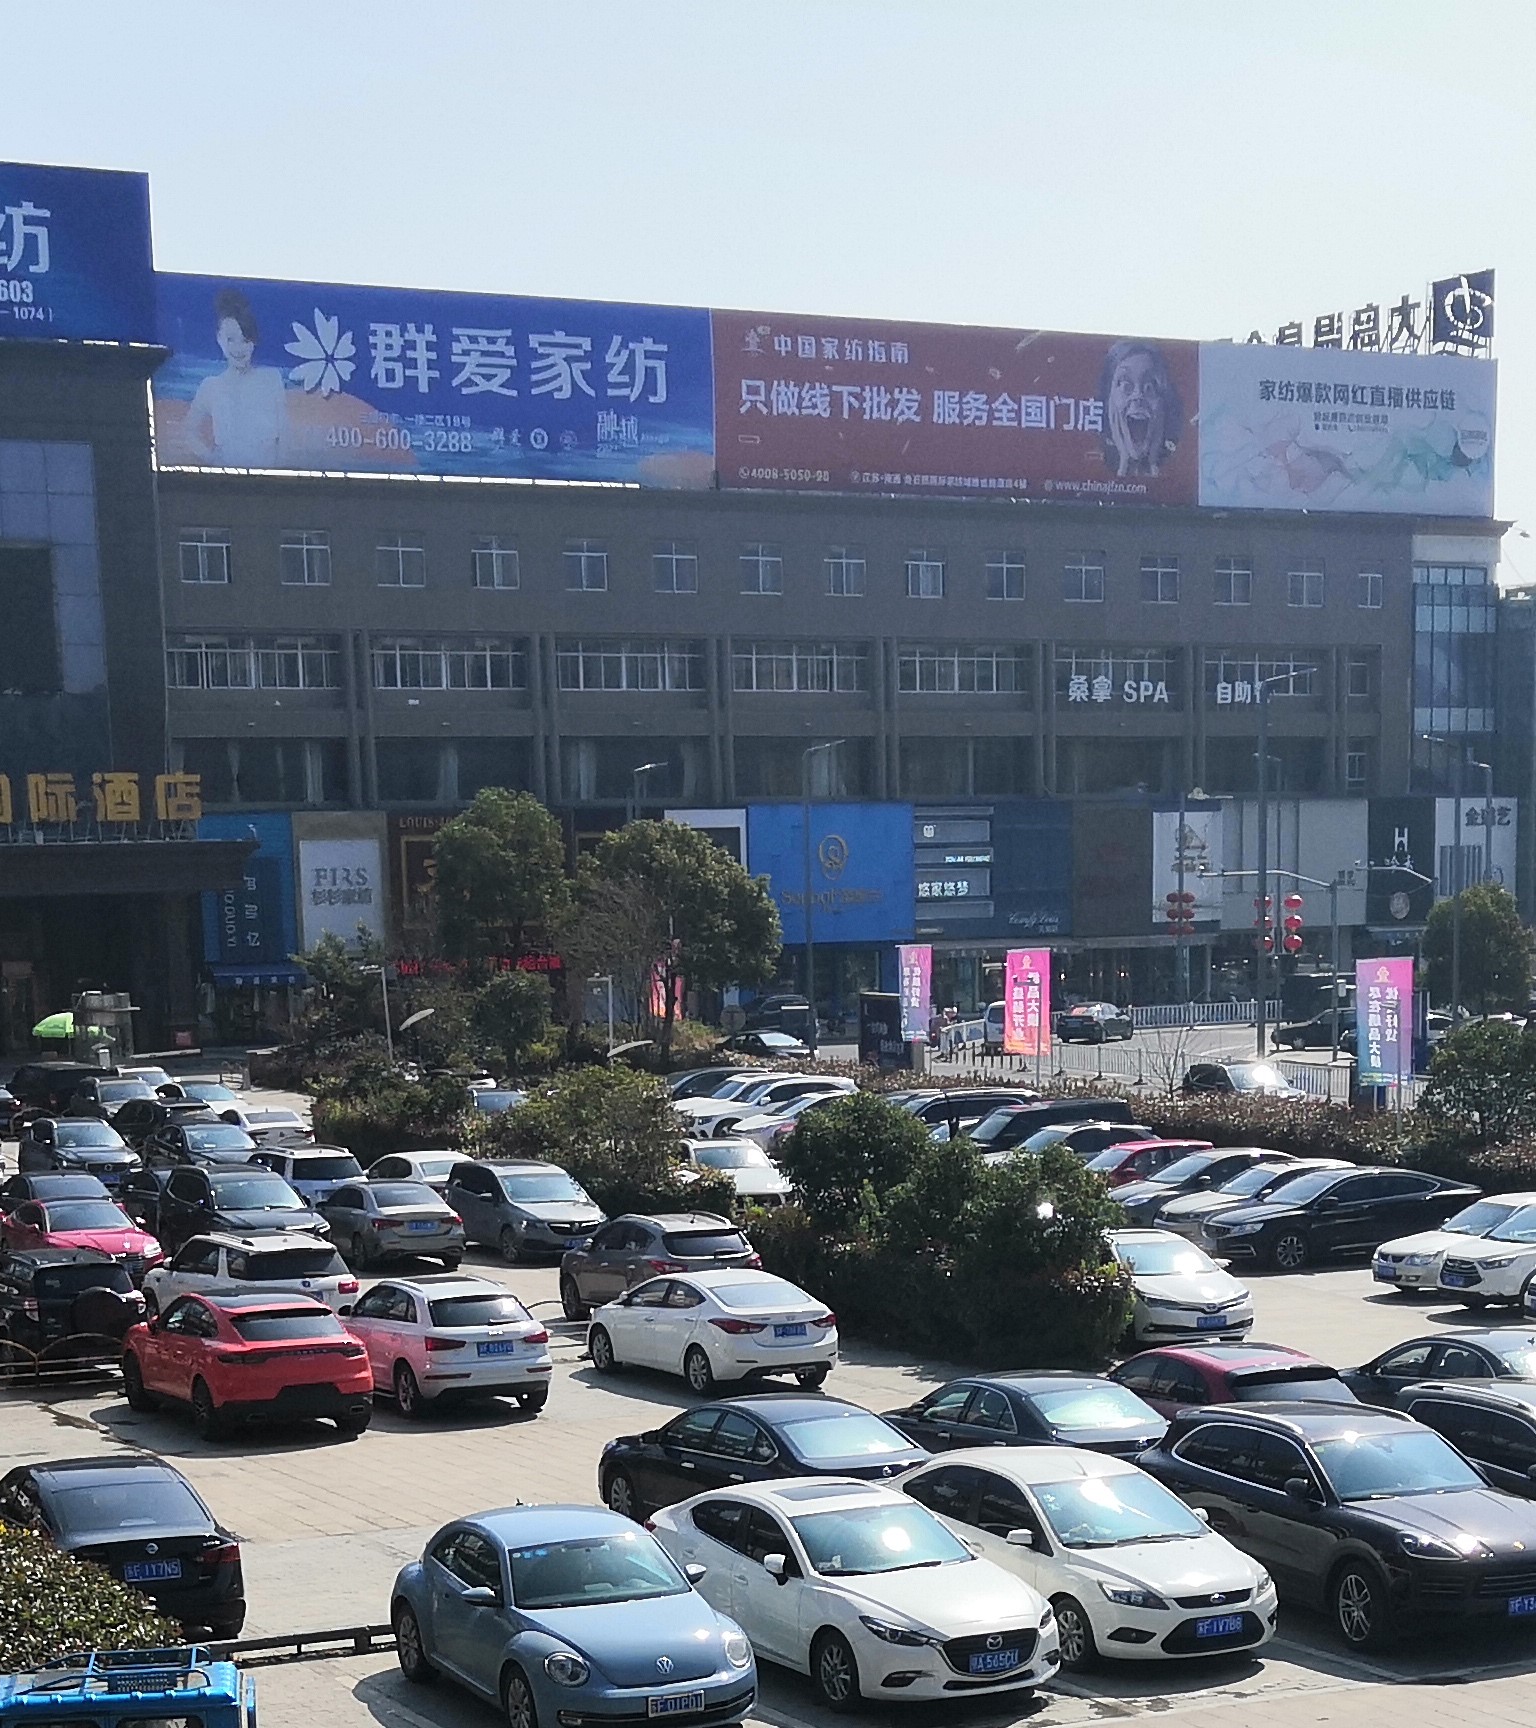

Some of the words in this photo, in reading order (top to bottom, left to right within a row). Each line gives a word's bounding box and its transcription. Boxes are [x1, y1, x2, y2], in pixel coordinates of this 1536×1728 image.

[369, 322, 668, 403] 群爱家纺
[773, 333, 911, 364] 中国家纺指南
[739, 378, 923, 424] 只做线下批发
[932, 389, 1106, 433] 服务全国门店
[324, 424, 472, 452] 400-600-3288
[1068, 675, 1112, 703] 桑拿
[1123, 680, 1169, 704] SPA
